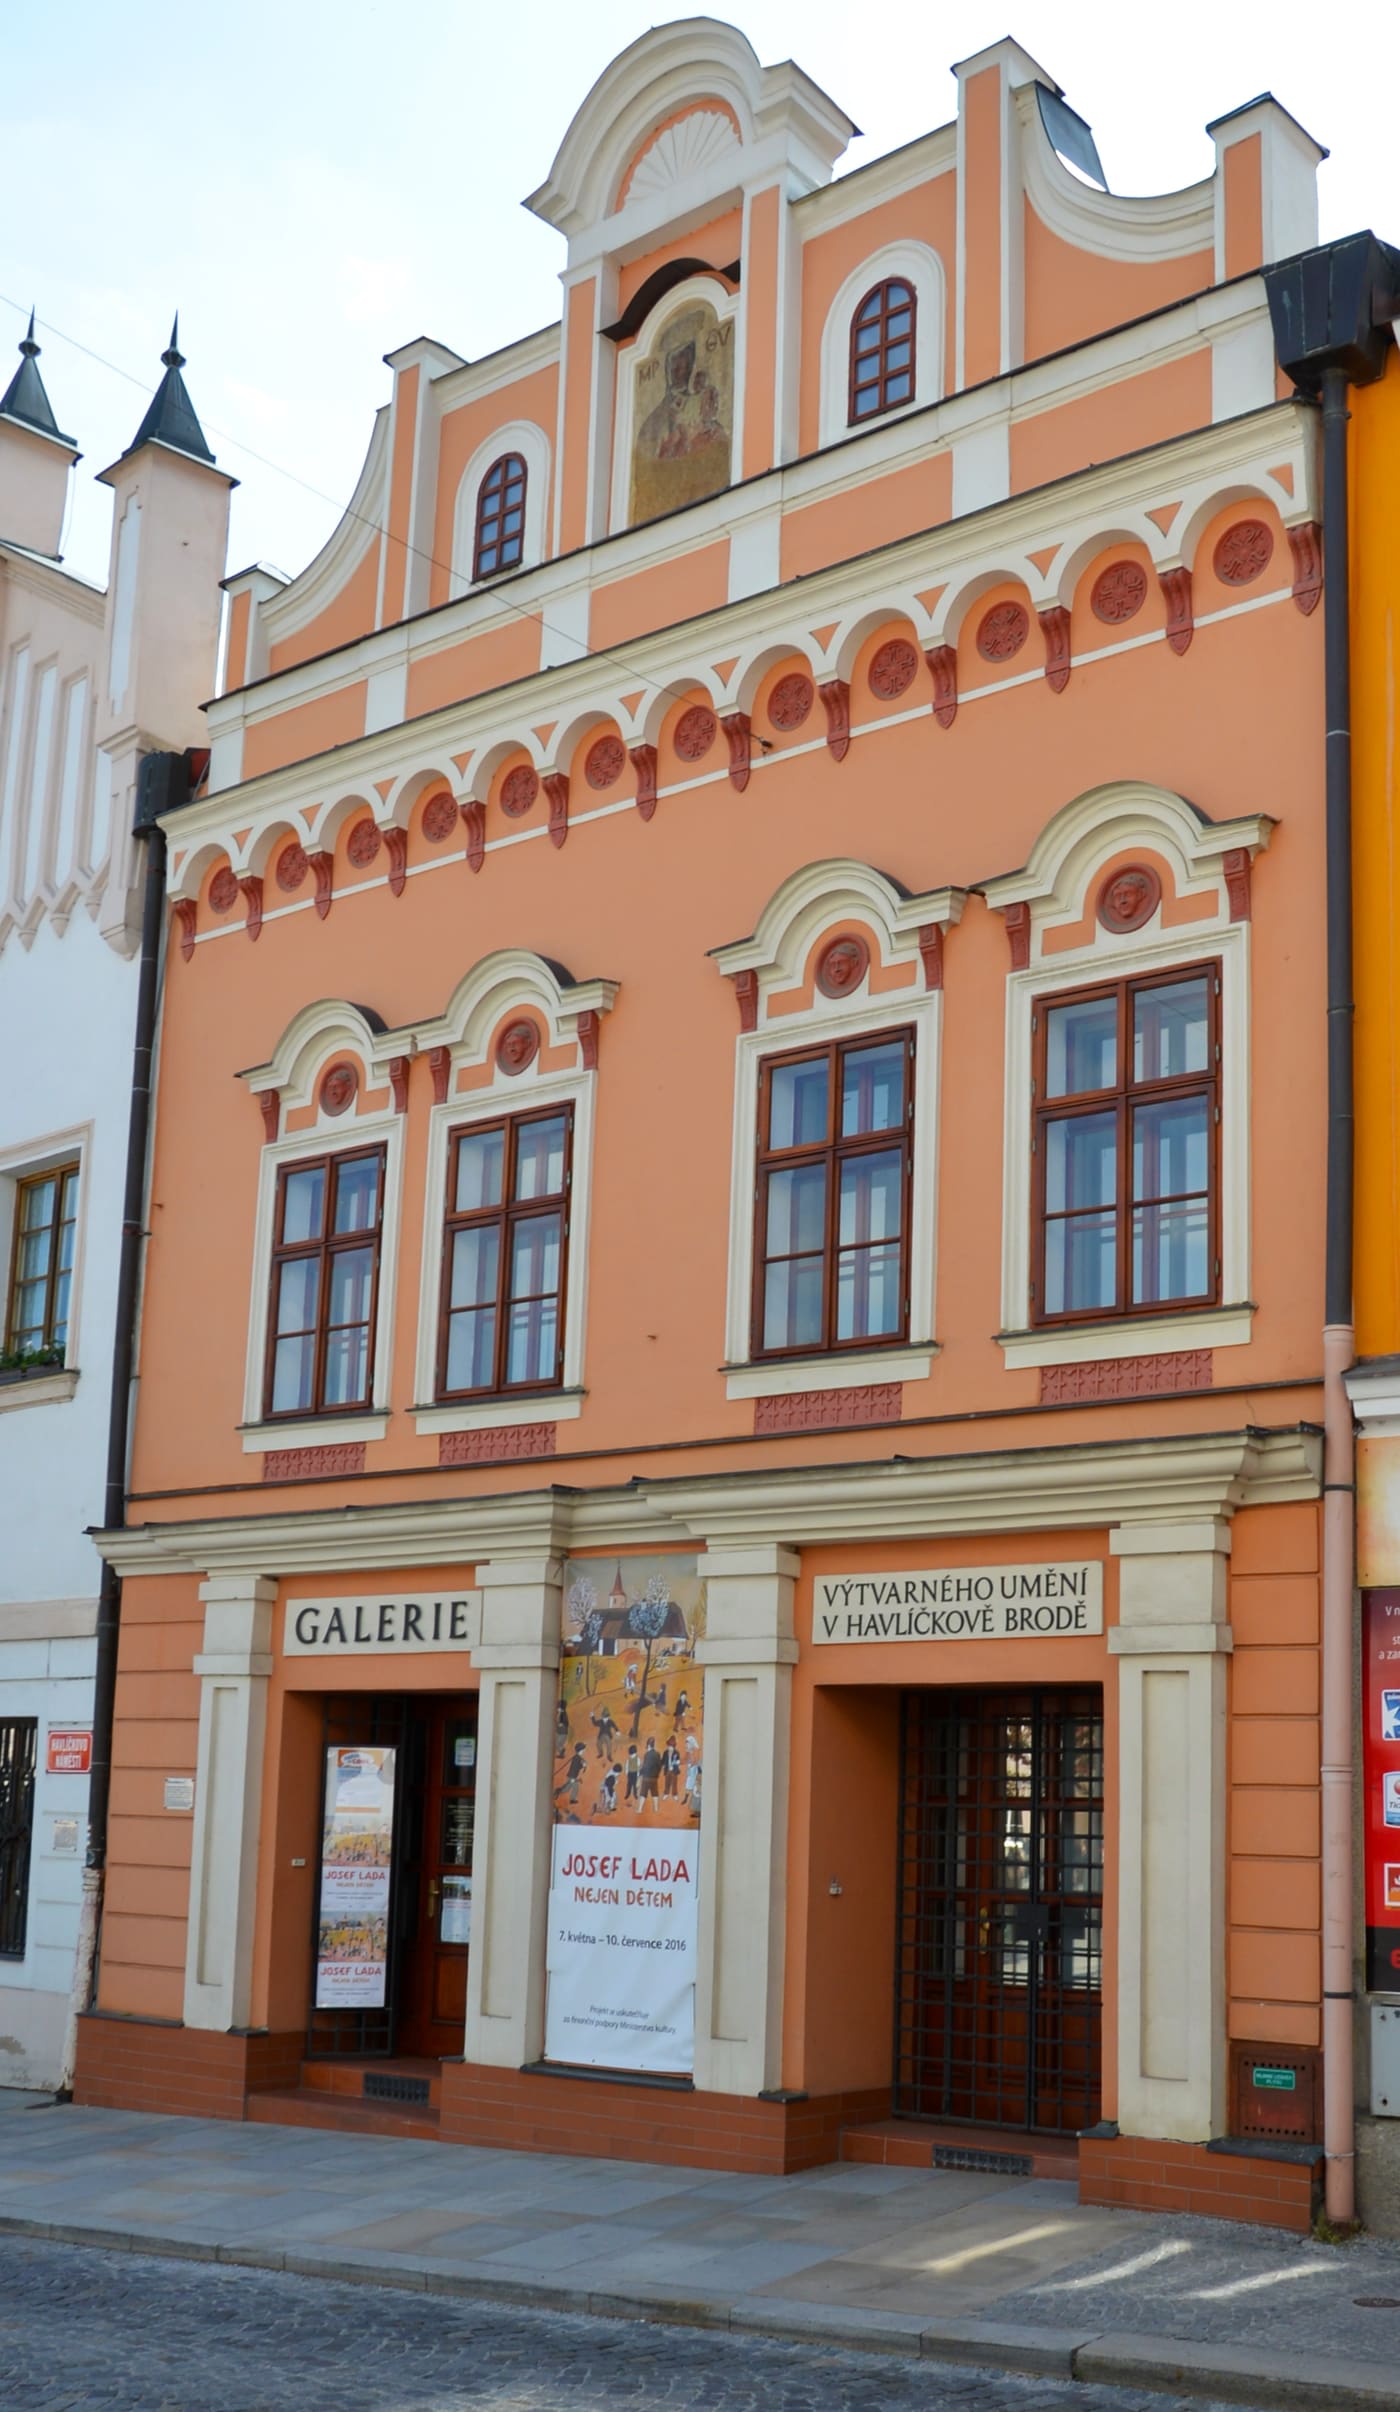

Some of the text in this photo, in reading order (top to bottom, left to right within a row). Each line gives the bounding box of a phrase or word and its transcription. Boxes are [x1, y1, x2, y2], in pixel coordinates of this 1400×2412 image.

[823, 1567, 1089, 1608] VÝTVARNÉHO UMĚNÍ
[295, 1600, 468, 1645] GALERIE
[822, 1600, 1088, 1638] V HAVLÍČKOVĚ BRODĚ
[325, 1871, 385, 1880] JOSEF LADA
[562, 1853, 690, 1883] JOSEF LADA
[574, 1886, 673, 1908] NEJEN DĚTEM
[559, 1930, 566, 1942] 7.
[568, 1931, 597, 1945] května
[606, 1935, 620, 1947] 10.
[621, 1935, 663, 1950] července
[665, 1938, 687, 1952] 2016
[320, 1967, 382, 1976] JOSEF LADA
